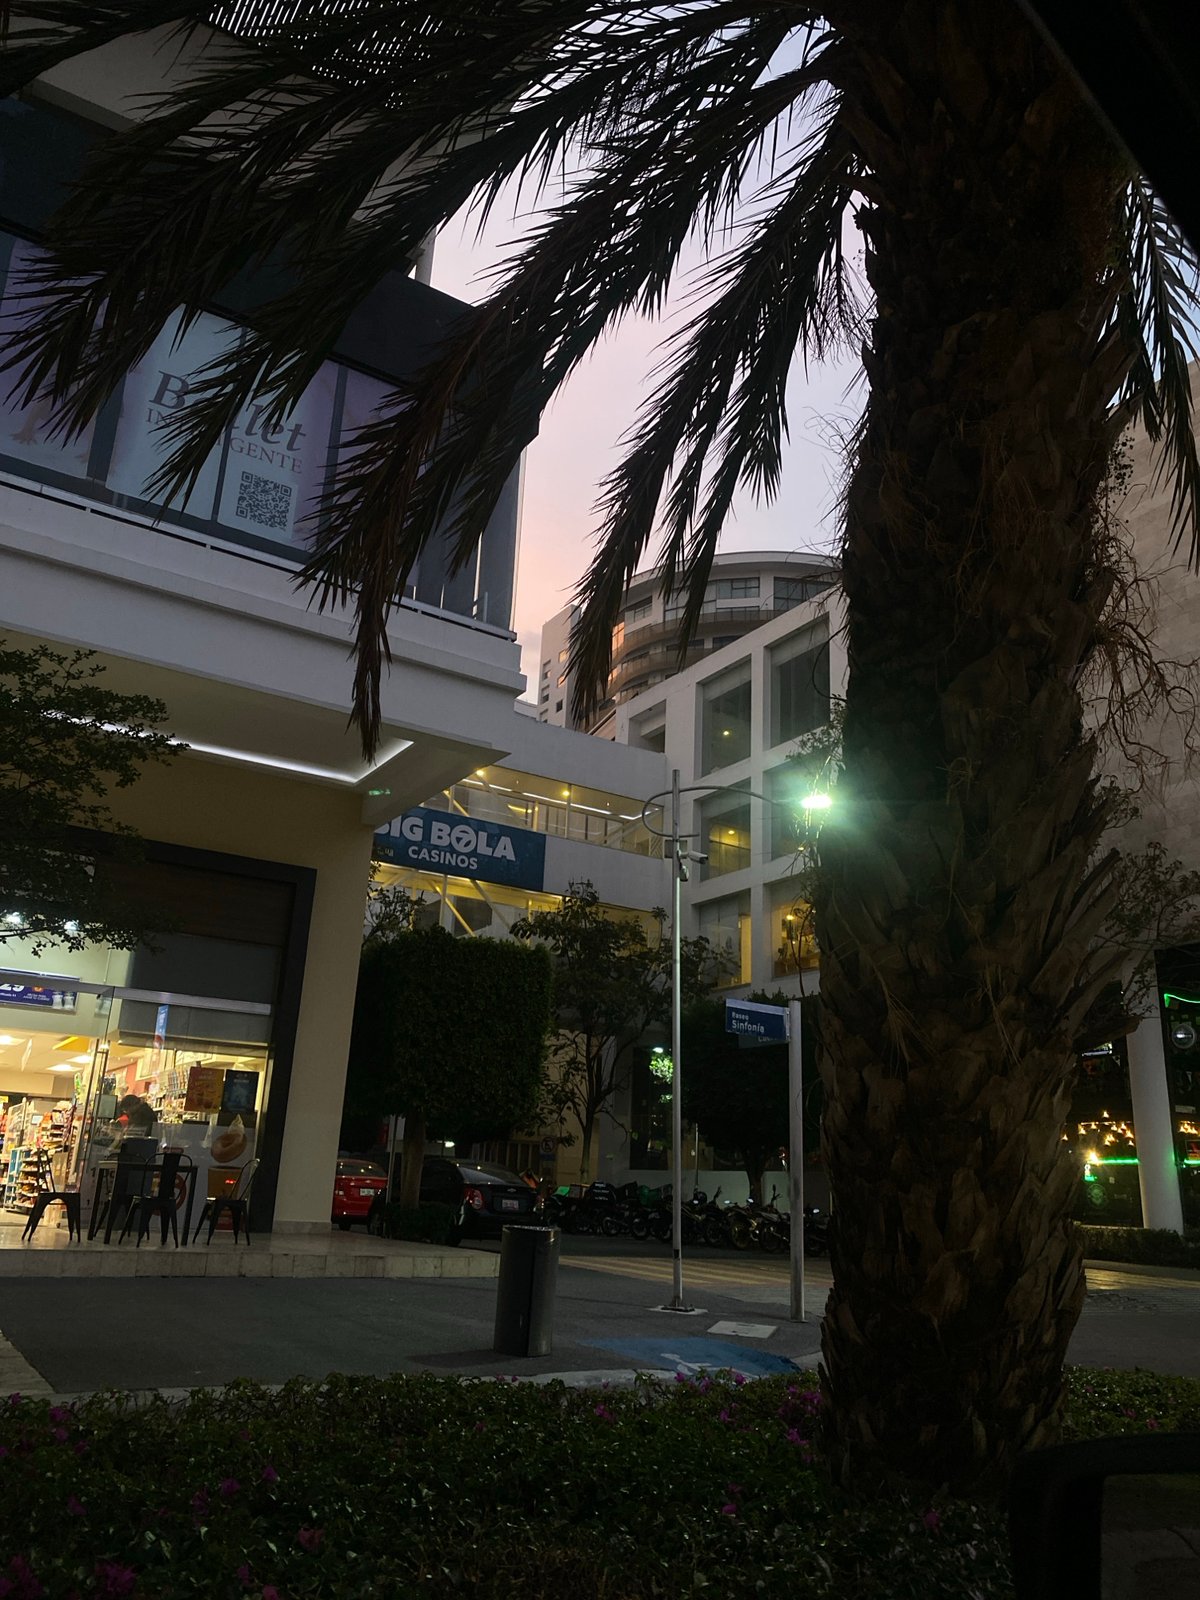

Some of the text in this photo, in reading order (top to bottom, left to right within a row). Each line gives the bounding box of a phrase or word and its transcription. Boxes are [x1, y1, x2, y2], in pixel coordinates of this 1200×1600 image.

[148, 370, 307, 452] Blet
[146, 408, 303, 474] INGENTE
[408, 845, 478, 871] CASINOS
[430, 820, 516, 862] BOLA
